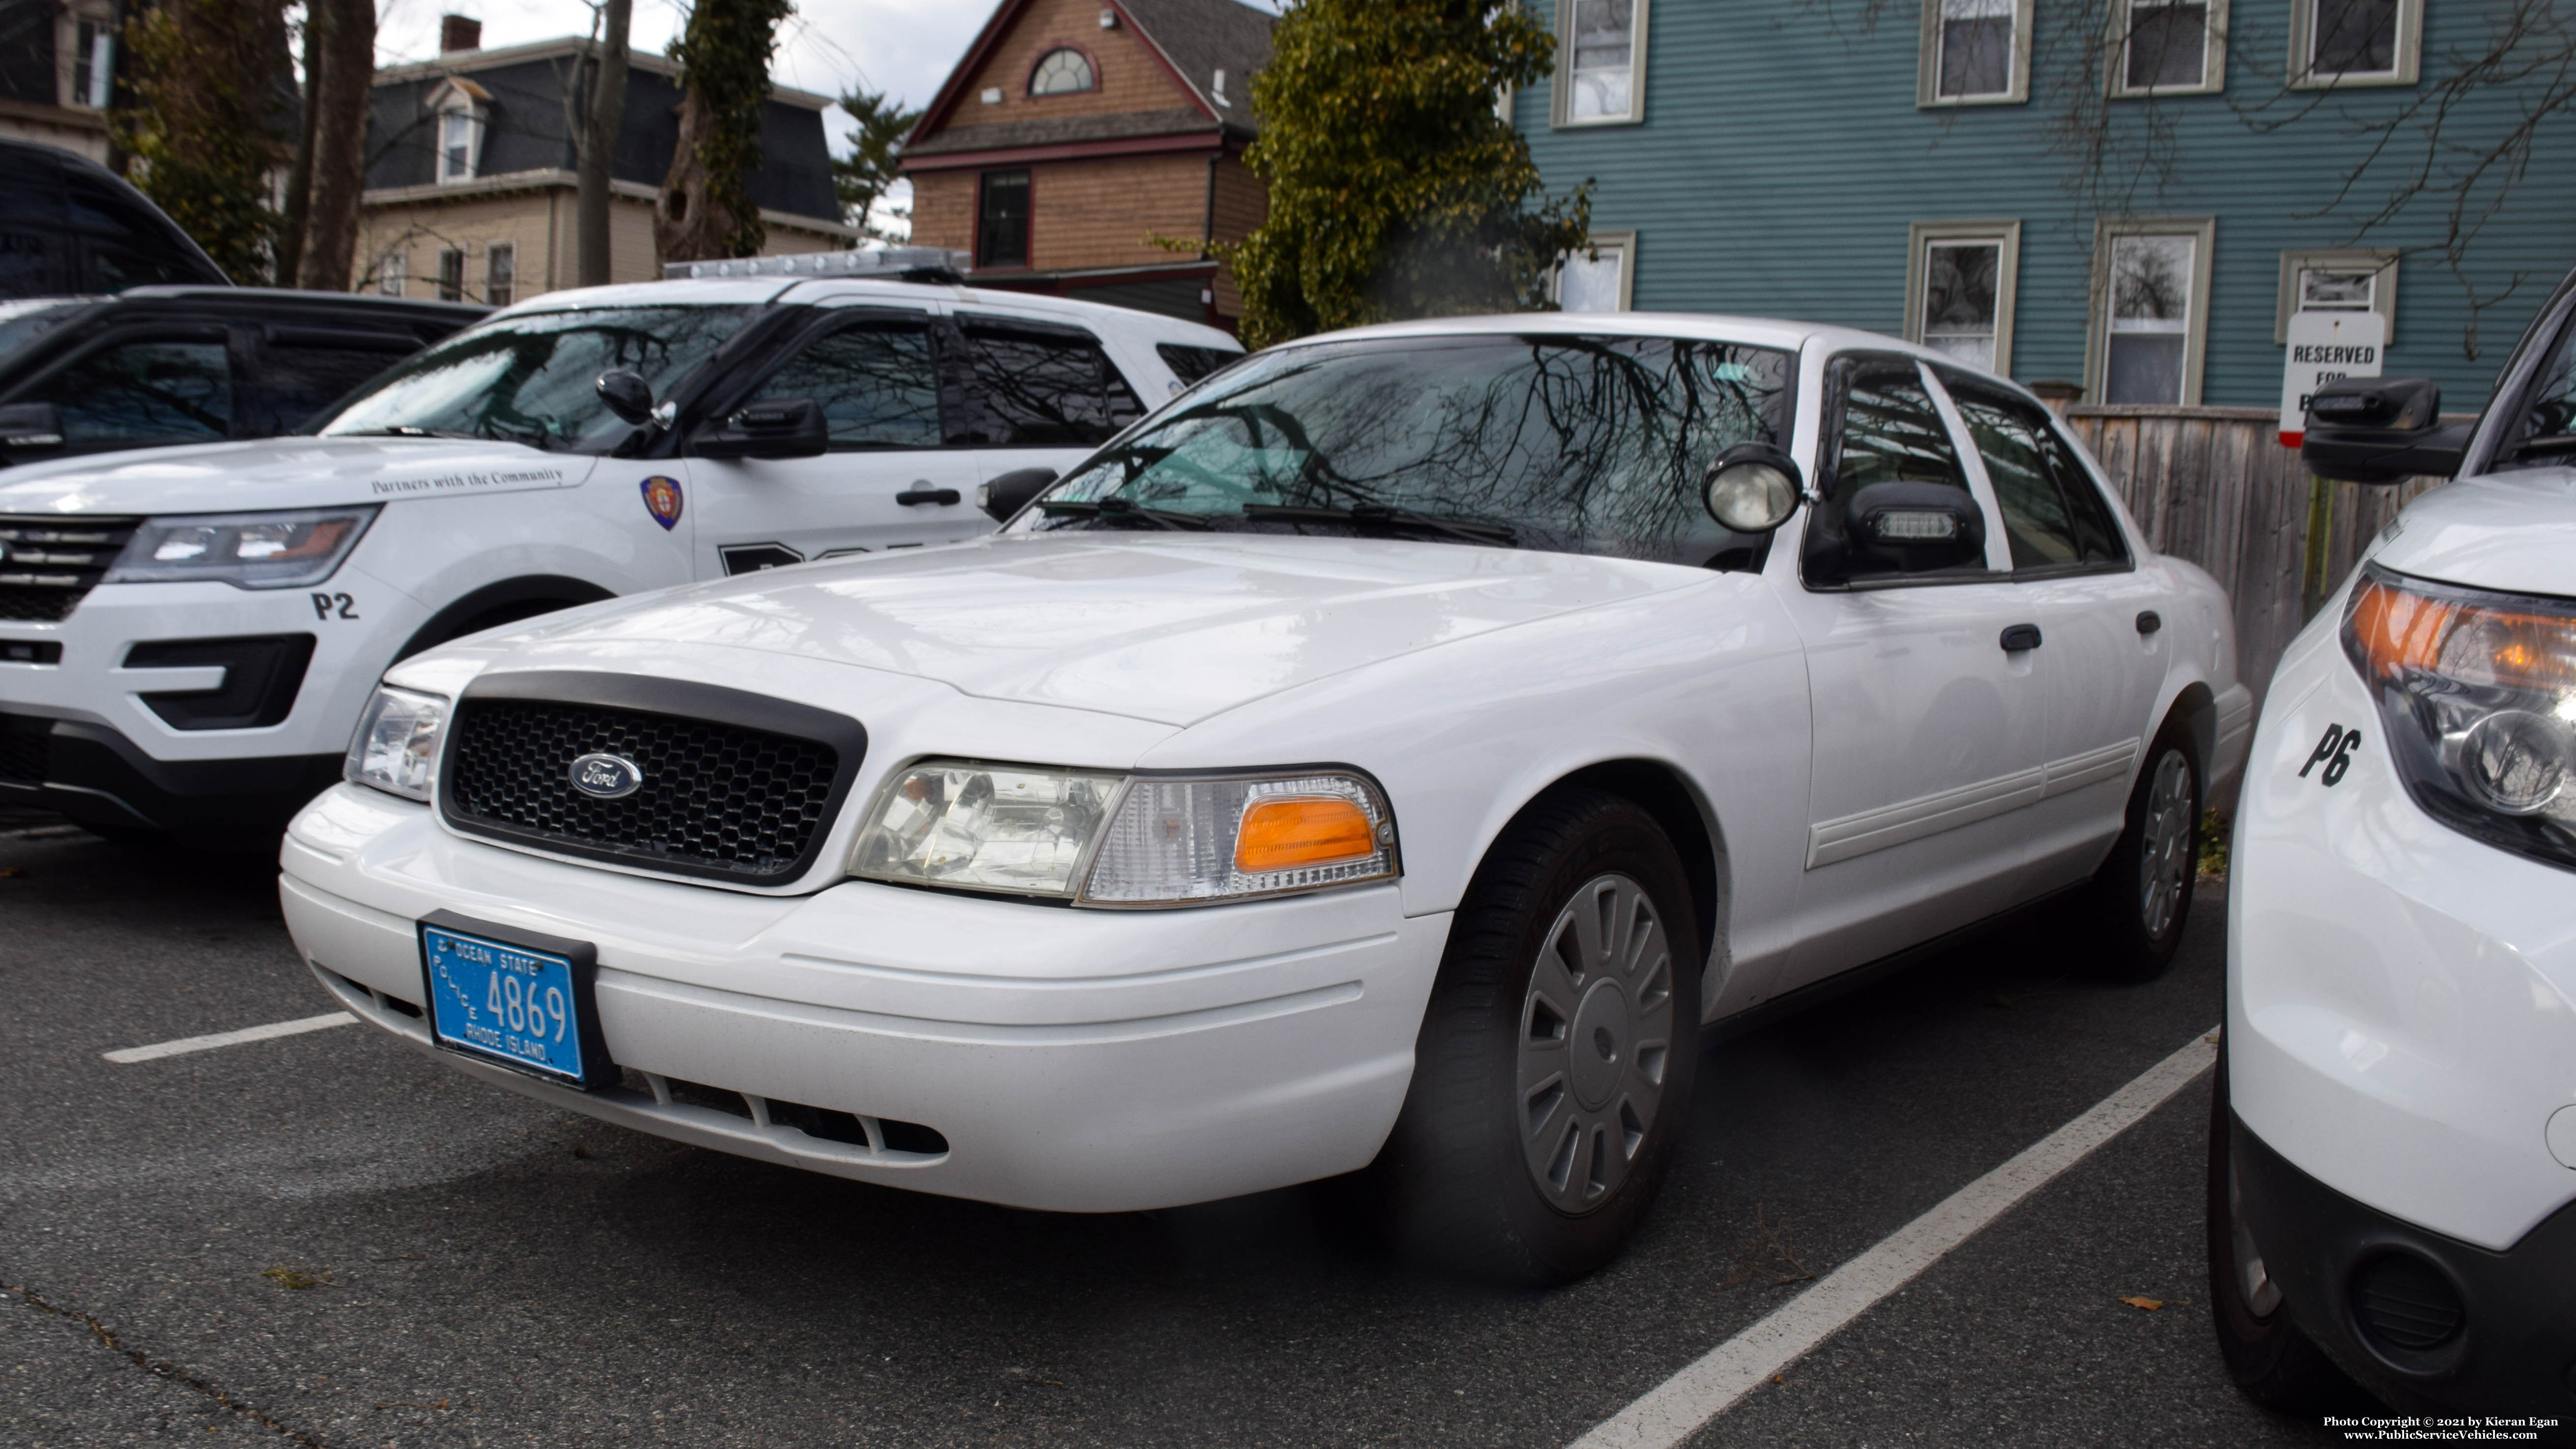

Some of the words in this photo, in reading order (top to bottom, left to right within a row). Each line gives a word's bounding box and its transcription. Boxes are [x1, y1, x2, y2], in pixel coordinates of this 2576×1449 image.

[2293, 346, 2375, 363] RESERVED
[371, 479, 430, 494] Partners
[434, 473, 464, 488] with
[468, 472, 488, 486] the
[491, 468, 563, 487] Community
[310, 592, 360, 620] P2
[2298, 723, 2361, 788] P6
[582, 761, 621, 787] Ford
[455, 942, 492, 964] OCEAN
[499, 954, 538, 977] STATE
[433, 954, 478, 1021] POLICE
[487, 970, 566, 1044] 4869
[466, 1023, 503, 1049] RHODE
[506, 1034, 547, 1061] ISLAND
